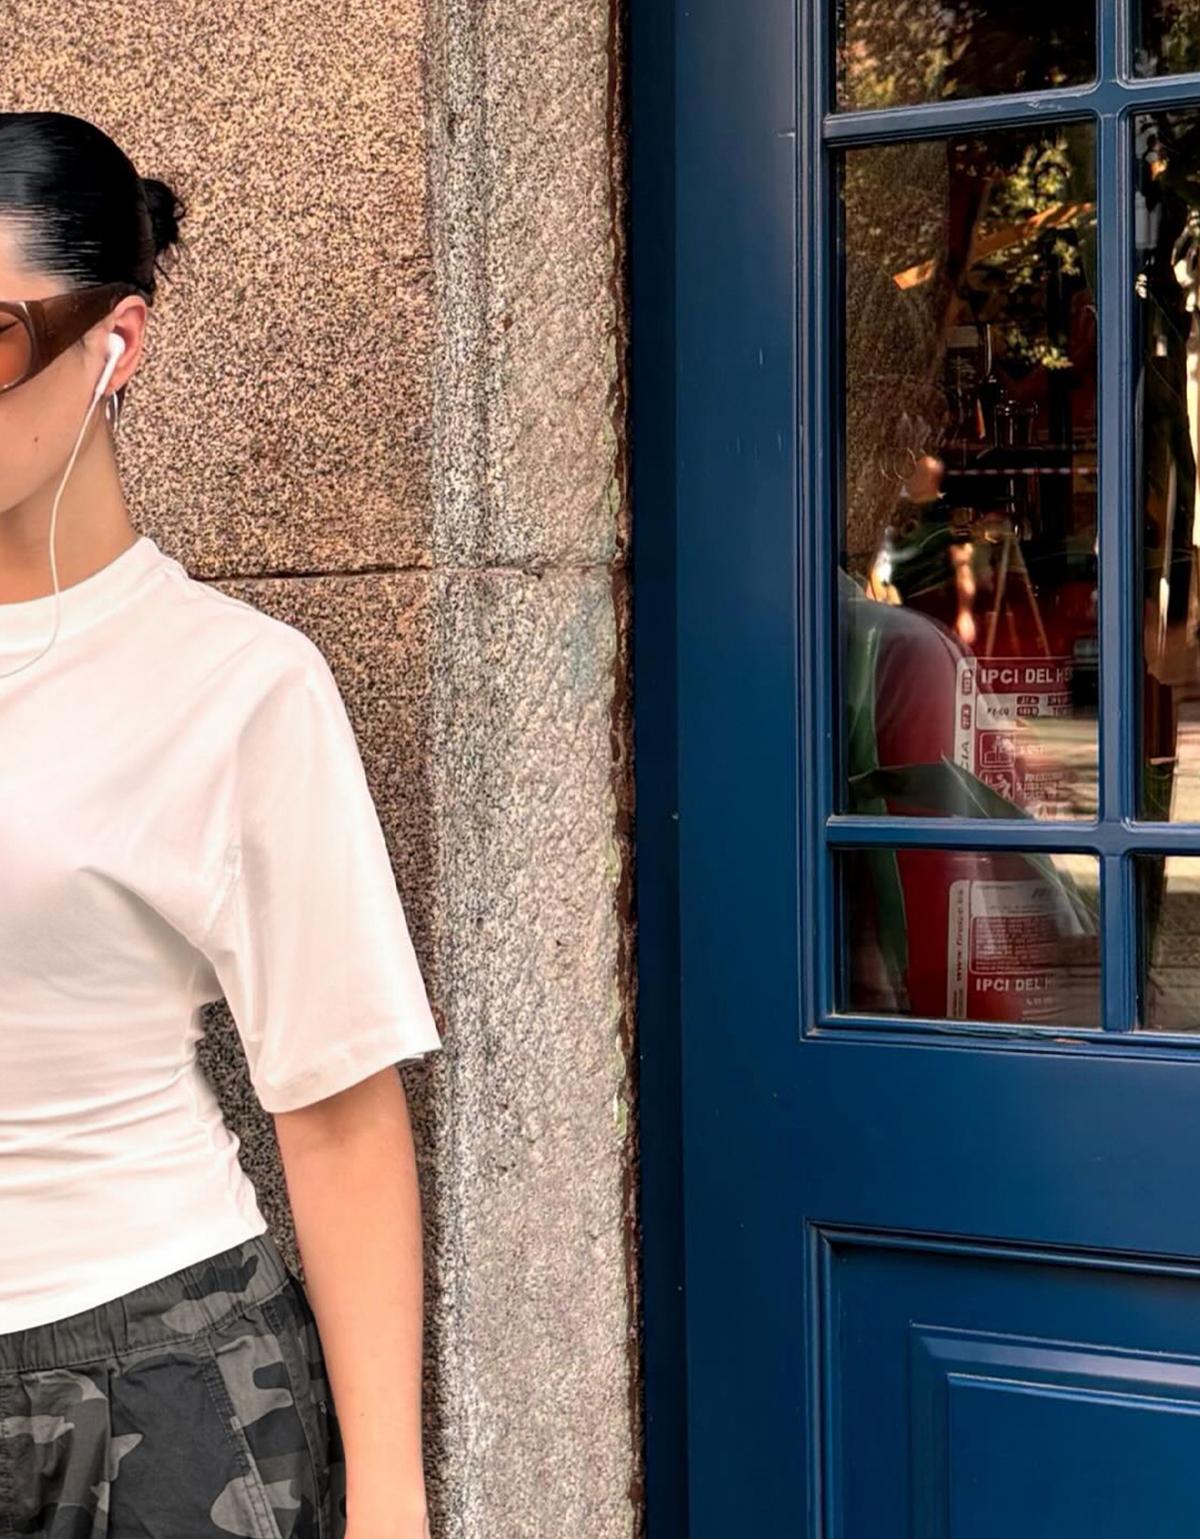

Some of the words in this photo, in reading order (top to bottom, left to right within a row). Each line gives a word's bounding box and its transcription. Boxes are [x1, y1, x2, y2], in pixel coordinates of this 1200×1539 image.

[981, 668, 1019, 684] IPCI
[1025, 668, 1054, 684] DEL
[976, 978, 1009, 992] IPCI
[1015, 978, 1040, 991] DEL
